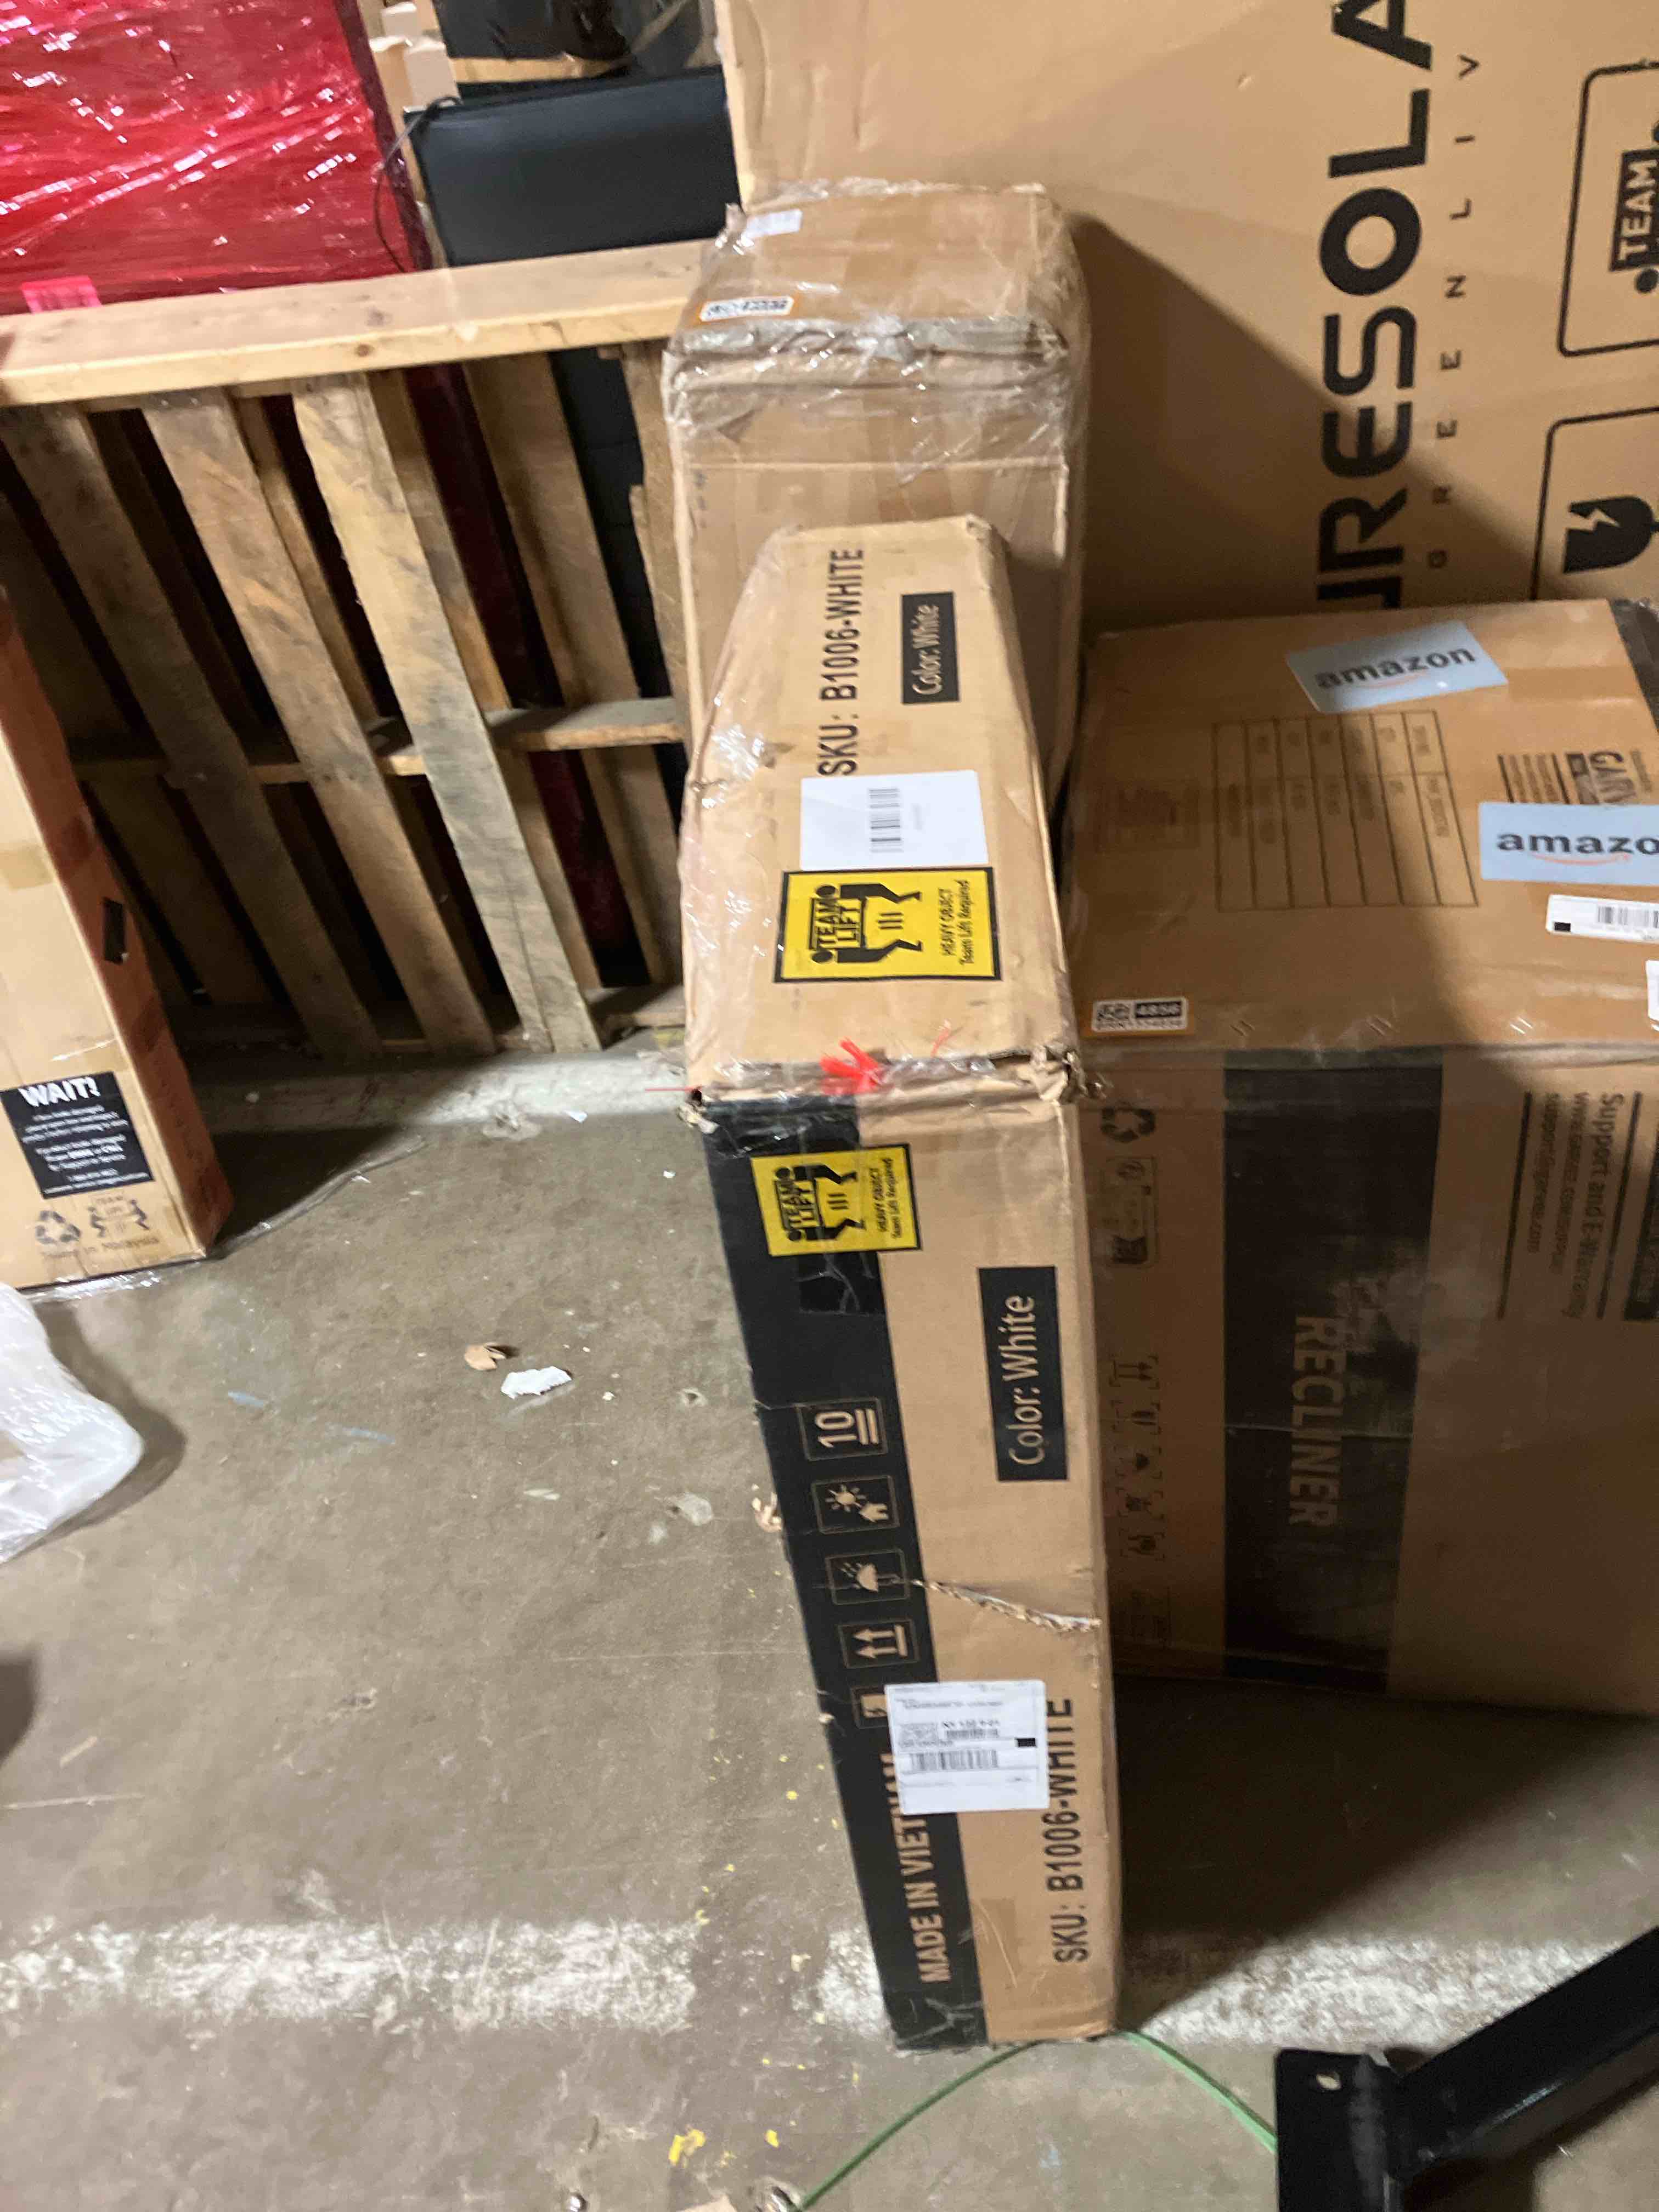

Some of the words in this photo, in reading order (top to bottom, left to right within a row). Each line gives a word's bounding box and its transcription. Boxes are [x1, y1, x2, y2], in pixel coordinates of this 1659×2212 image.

[1617, 159, 1658, 262] TEAM
[819, 549, 864, 701] B1006-WHITE
[910, 603, 940, 650] White
[911, 650, 943, 695] Color:
[1316, 646, 1476, 690] amazon
[817, 713, 860, 777] SKU:
[938, 887, 956, 921] OBJECT
[954, 879, 976, 920] Required
[816, 899, 839, 951] TEAM
[837, 905, 859, 941] LIFT
[939, 923, 957, 957] HEAVY
[957, 922, 974, 939] Lift
[959, 939, 975, 966] Team
[18, 1076, 101, 1107] WAIT!
[1591, 1092, 1626, 1178] Support
[1583, 1181, 1606, 1217] and
[997, 1294, 1040, 1383] White
[814, 1410, 857, 1448] 10
[1006, 1385, 1045, 1465] Color:
[1289, 1316, 1347, 1528] RECLINER
[904, 1881, 941, 1909] IN
[908, 1912, 952, 1984] MADE
[1050, 1904, 1088, 1962] SKU:
